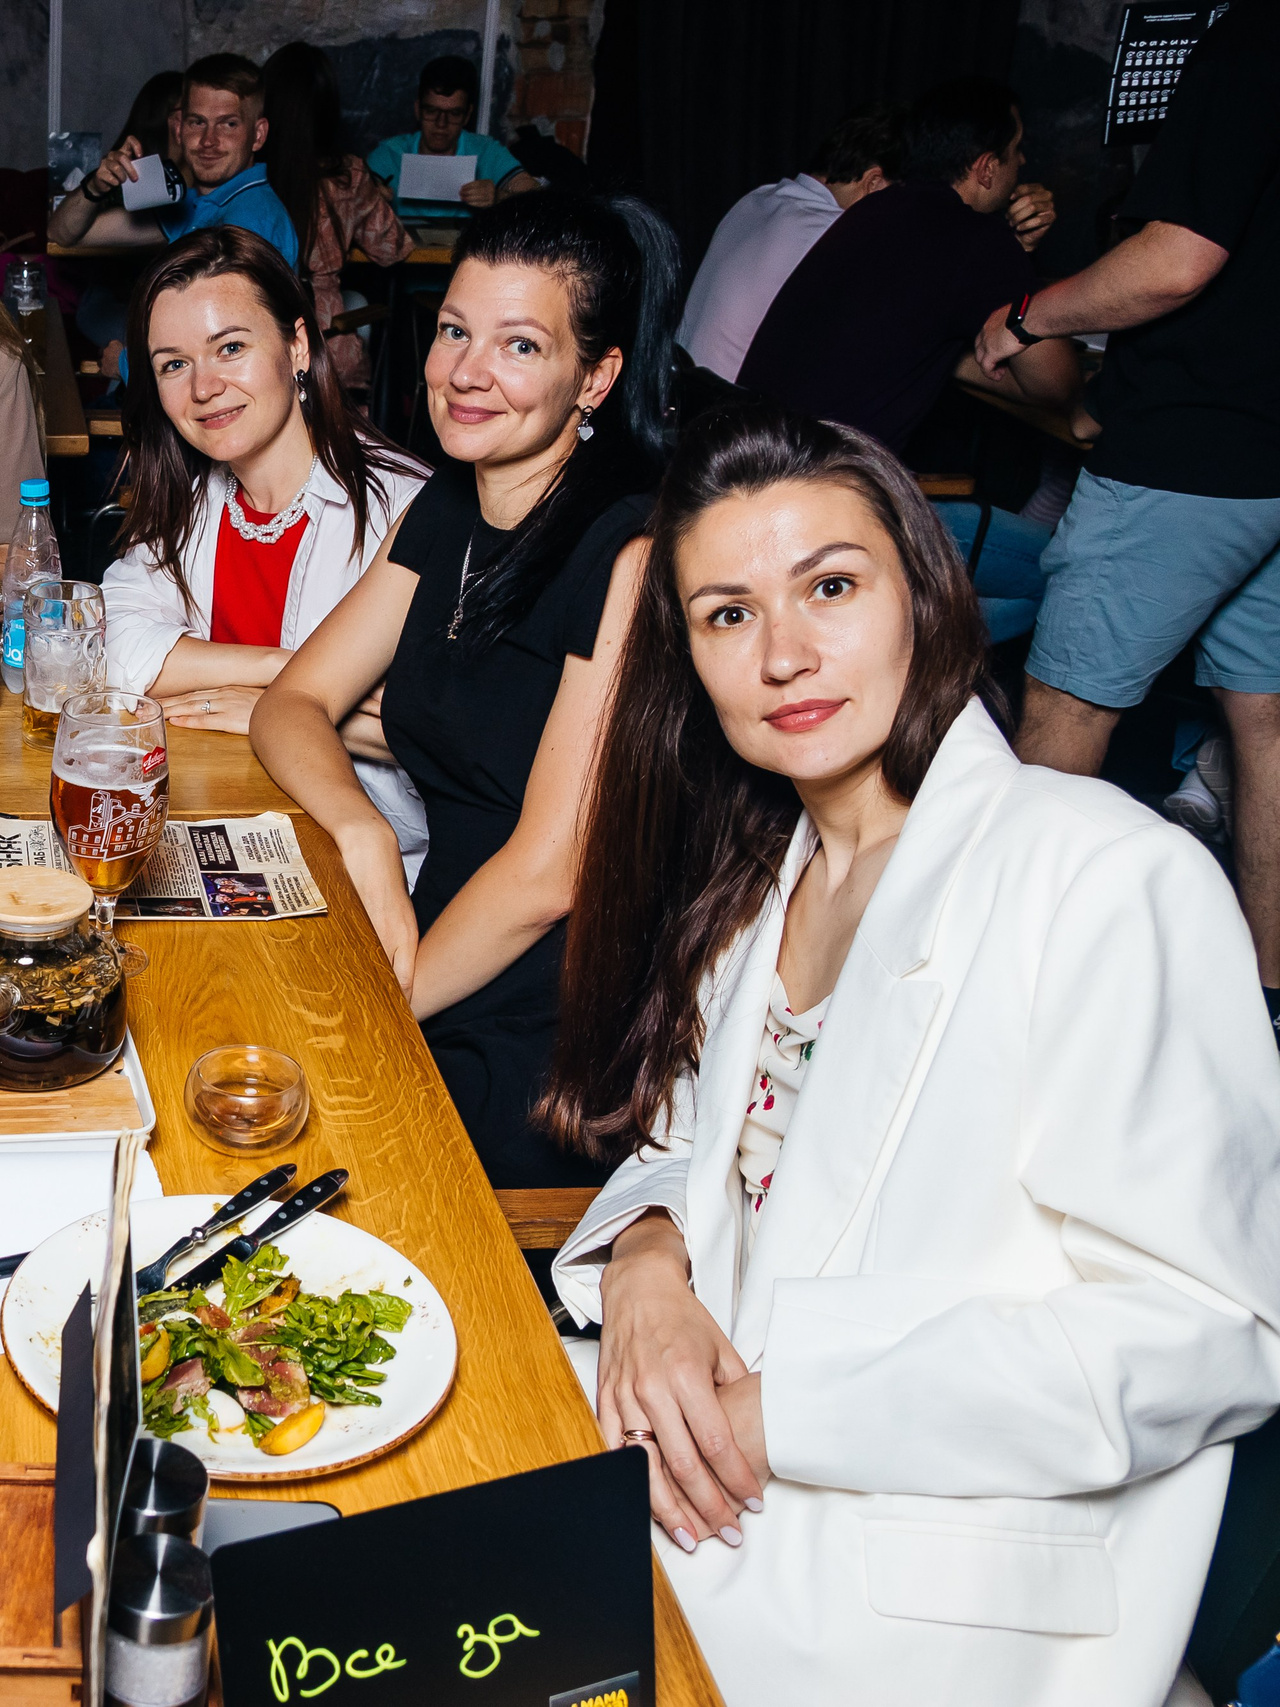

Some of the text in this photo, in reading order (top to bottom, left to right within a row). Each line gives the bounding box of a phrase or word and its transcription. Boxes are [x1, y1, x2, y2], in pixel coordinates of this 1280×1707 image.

[245, 845, 255, 860] СКИДКА
[266, 1613, 540, 1703] Все за
